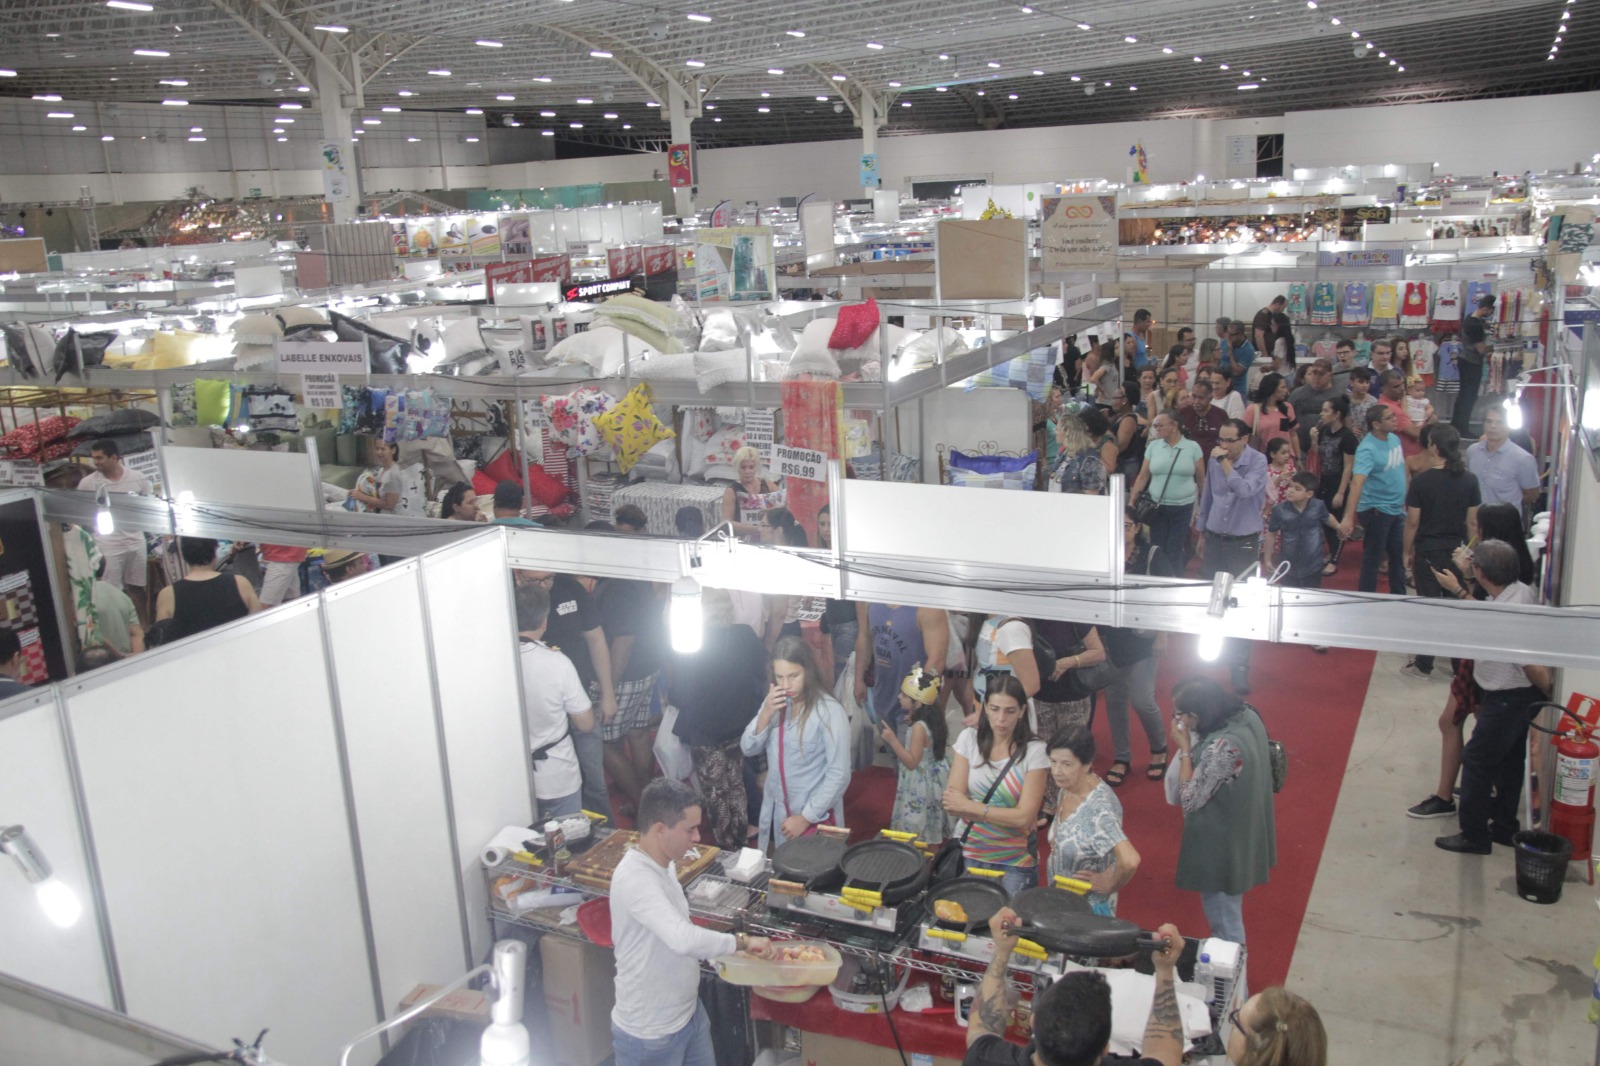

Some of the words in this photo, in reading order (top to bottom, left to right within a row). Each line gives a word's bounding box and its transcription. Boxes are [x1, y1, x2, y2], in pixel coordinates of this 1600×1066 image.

[578, 284, 601, 298] SPORT
[602, 279, 631, 294] COMPANY
[280, 354, 317, 362] LABELLE
[319, 354, 363, 363] ENXOVAIS
[777, 448, 822, 465] PROMOÇÃO
[871, 625, 908, 654] RNAVAL
